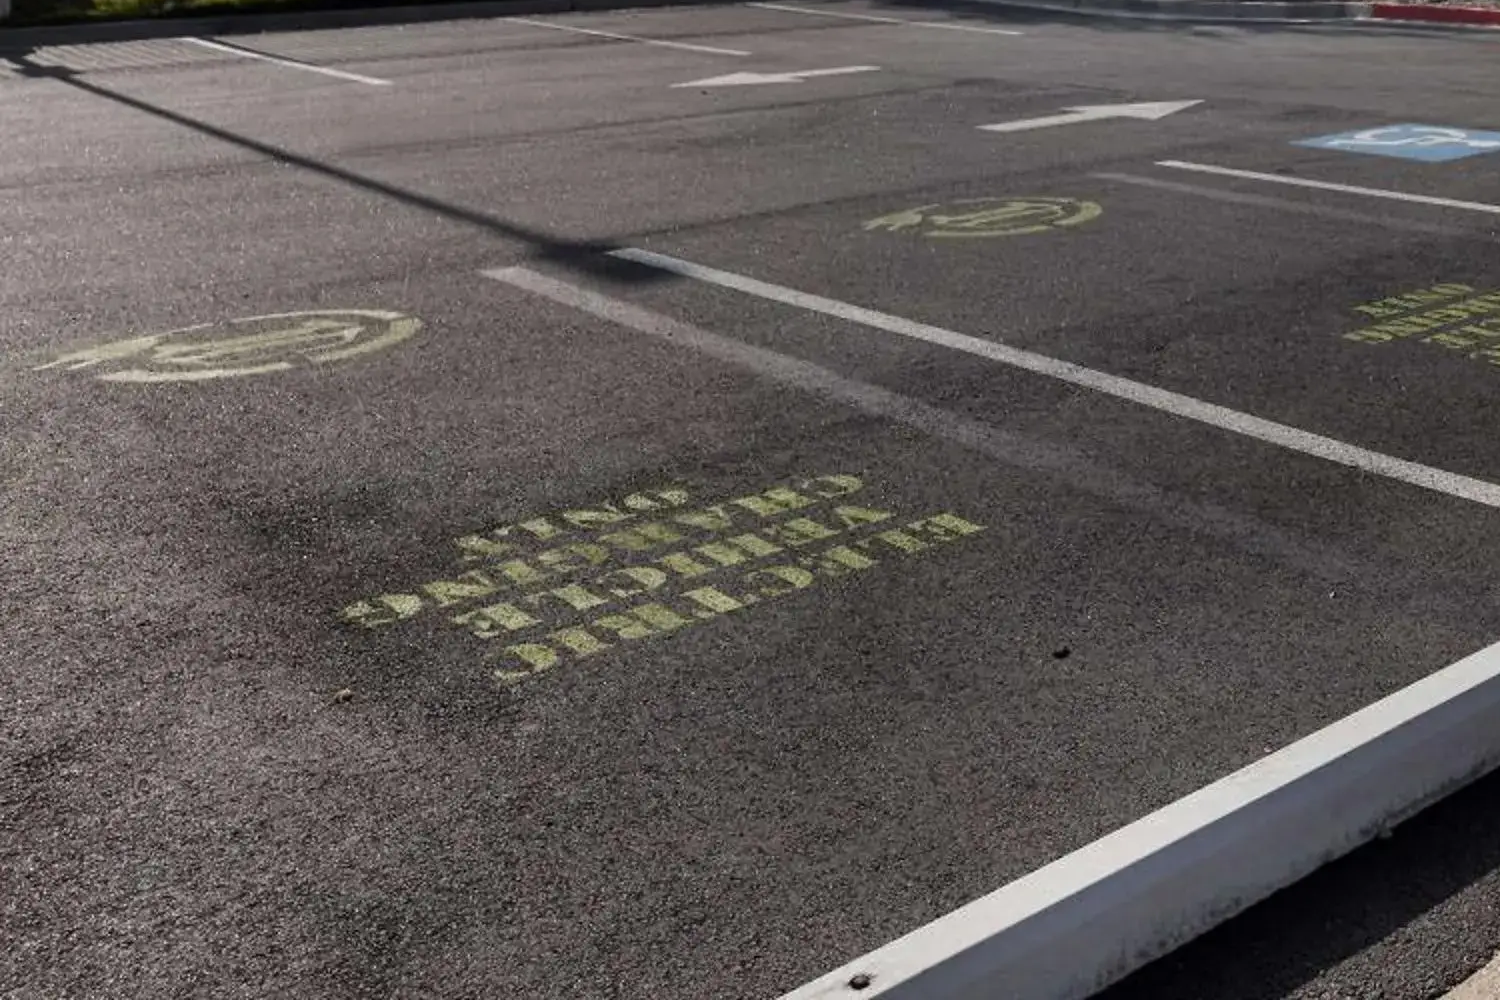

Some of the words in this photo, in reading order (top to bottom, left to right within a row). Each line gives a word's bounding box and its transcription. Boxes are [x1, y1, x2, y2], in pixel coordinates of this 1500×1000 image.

[340, 473, 864, 630] CHARGING
[451, 503, 894, 638] VEHICLE
[490, 511, 988, 681] ELECTRIC
